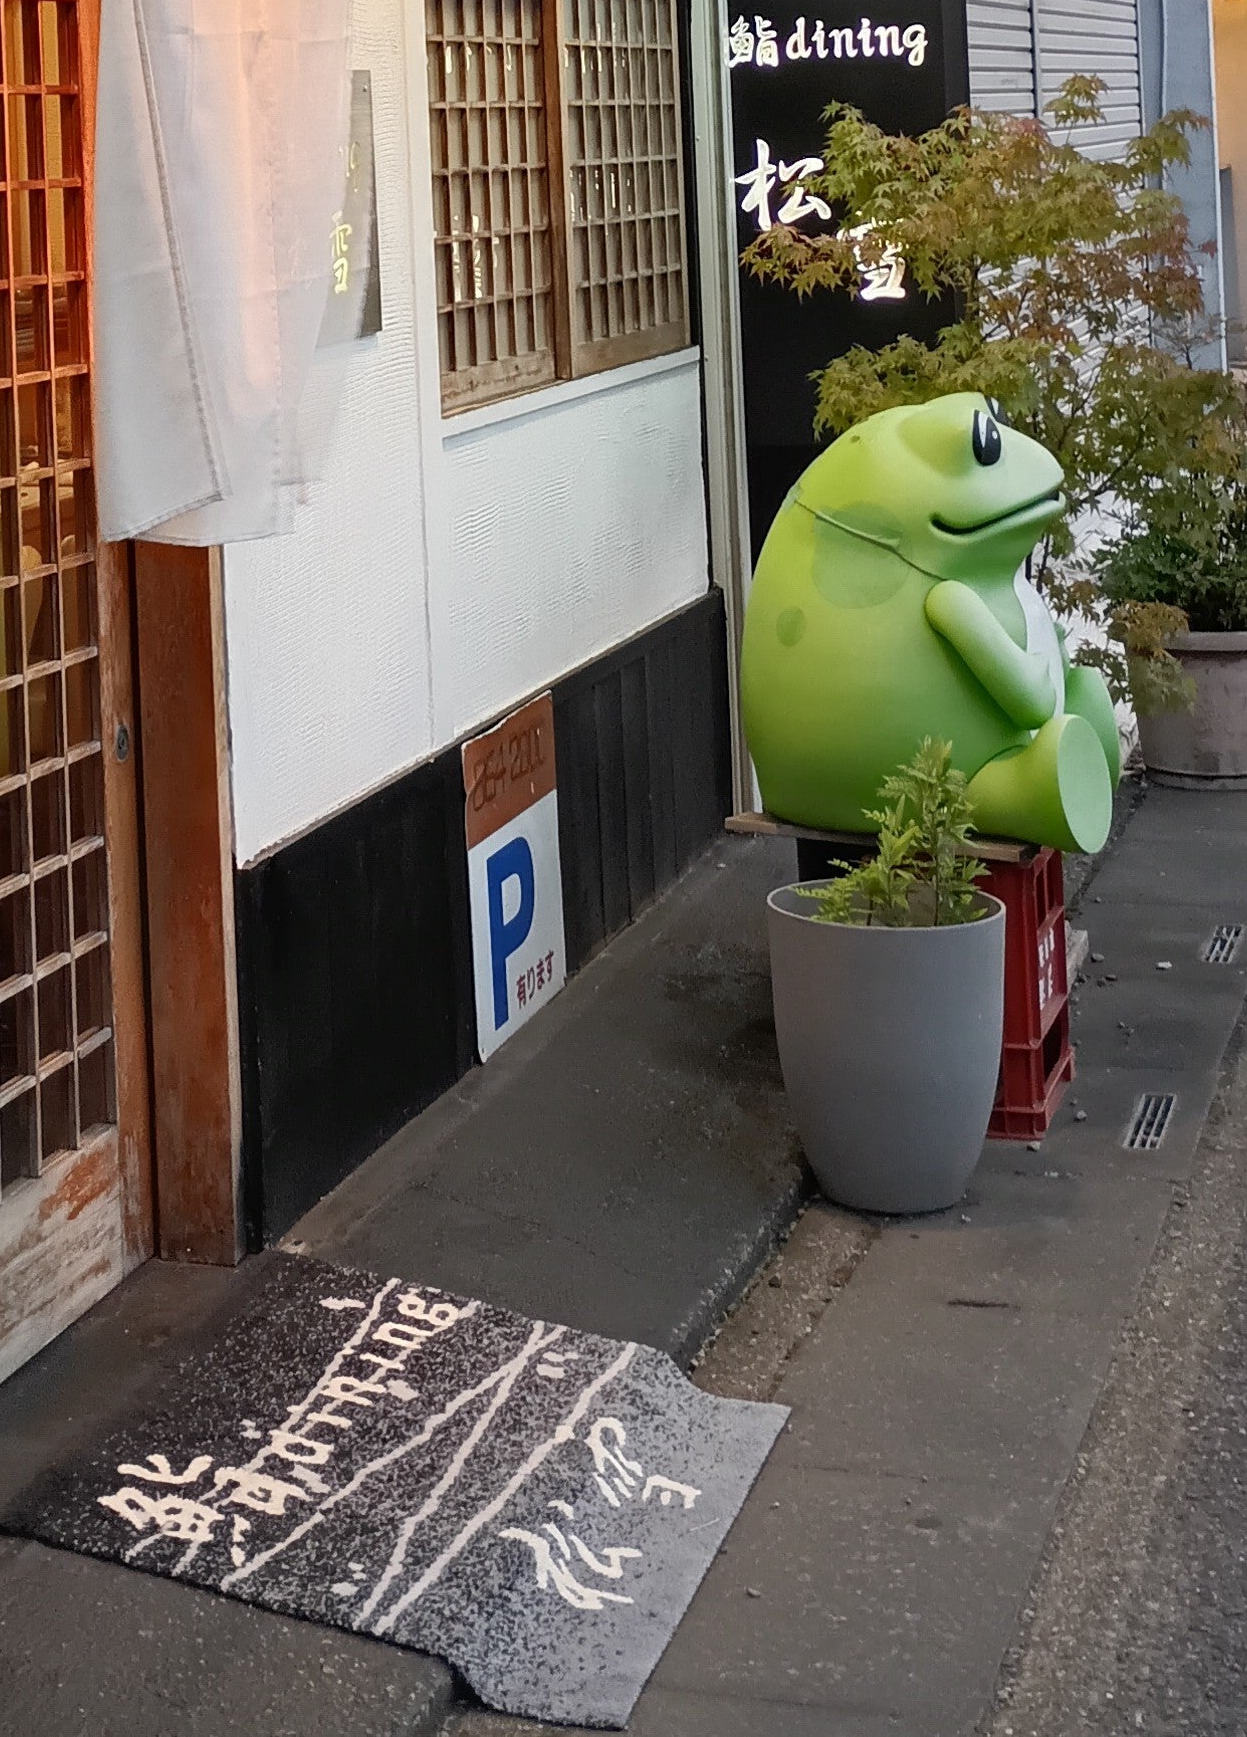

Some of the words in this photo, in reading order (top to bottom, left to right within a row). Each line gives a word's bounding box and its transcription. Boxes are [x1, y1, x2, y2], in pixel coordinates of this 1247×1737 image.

[486, 836, 535, 1031] P
[516, 949, 554, 1010] 有ります
